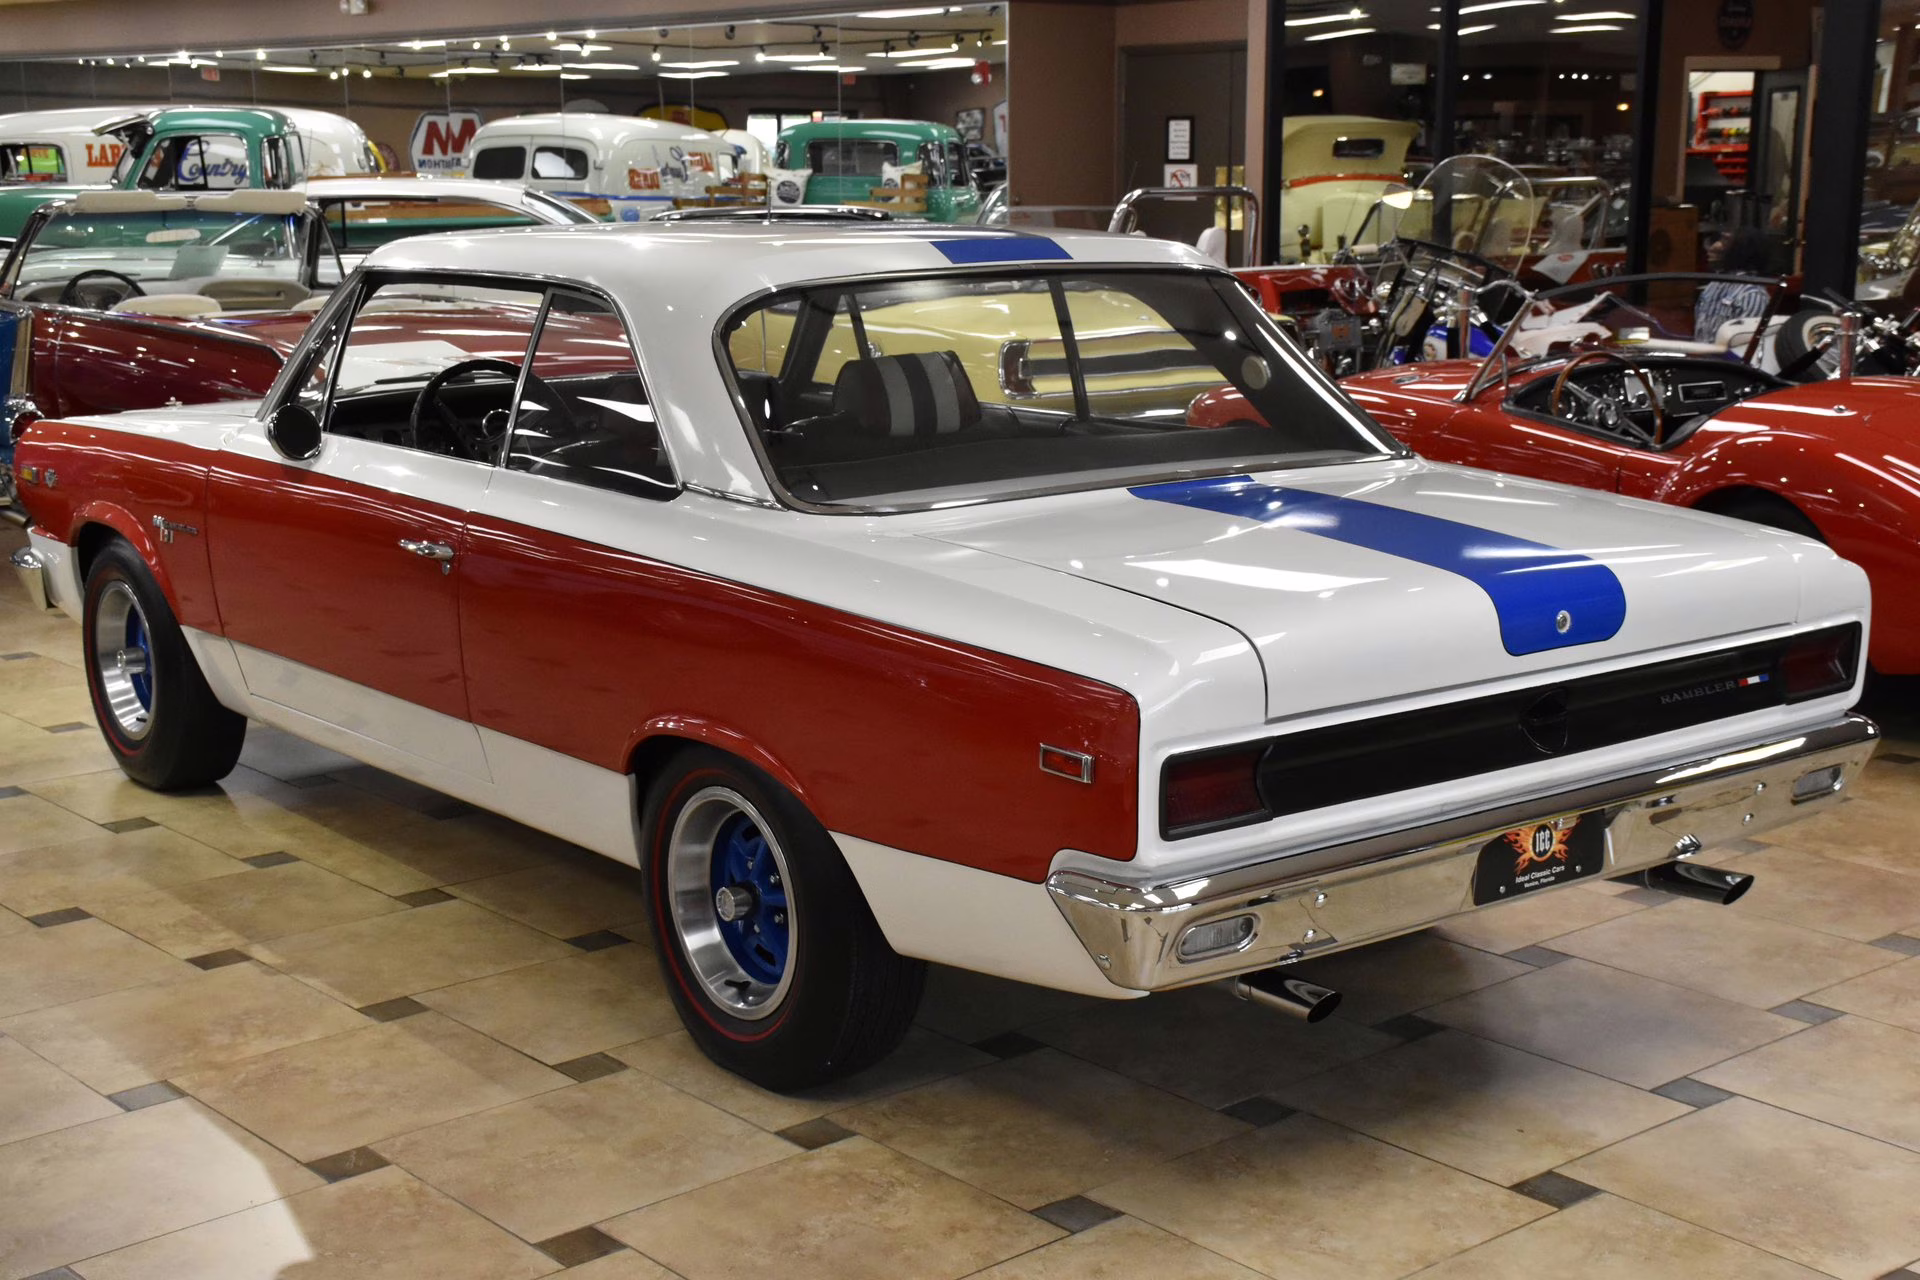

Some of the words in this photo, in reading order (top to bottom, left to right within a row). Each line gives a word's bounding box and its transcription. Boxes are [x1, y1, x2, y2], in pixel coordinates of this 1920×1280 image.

[178, 140, 248, 184] Country
[1660, 680, 1736, 704] RAMBLER
[1515, 874, 1530, 883] Ideal
[1531, 869, 1550, 879] Classic
